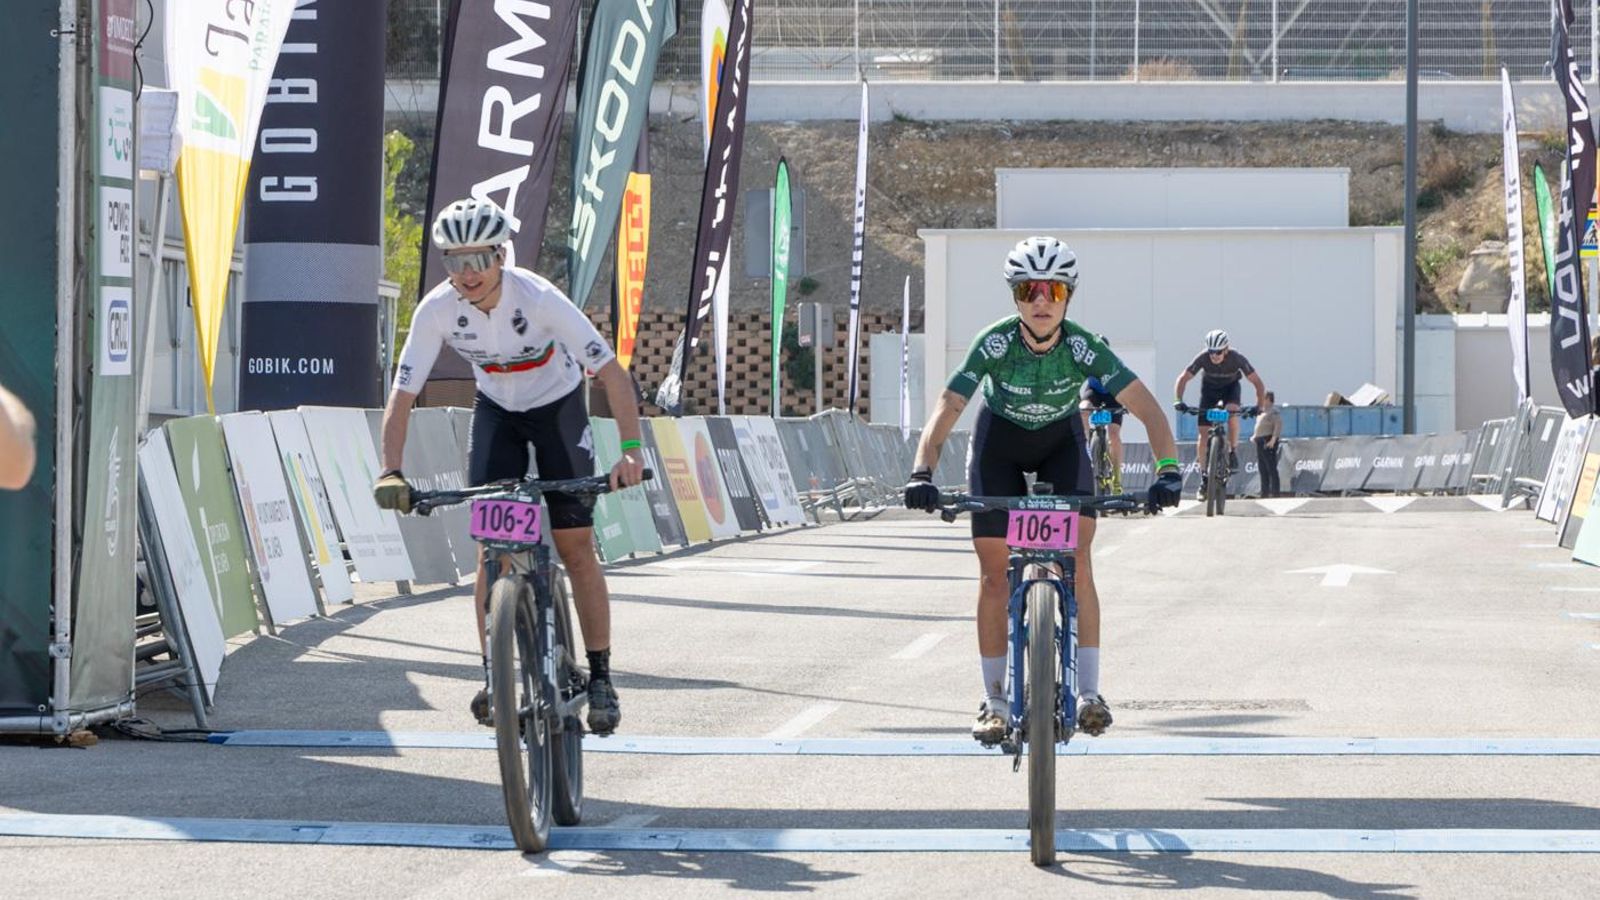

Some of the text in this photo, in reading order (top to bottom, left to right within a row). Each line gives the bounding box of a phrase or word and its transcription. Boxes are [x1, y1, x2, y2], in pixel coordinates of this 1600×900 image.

[248, 357, 334, 375] GOBIK.COM
[1373, 456, 1404, 469] GARMIN
[479, 504, 536, 535] 106-2
[1015, 514, 1072, 543] 106-1
